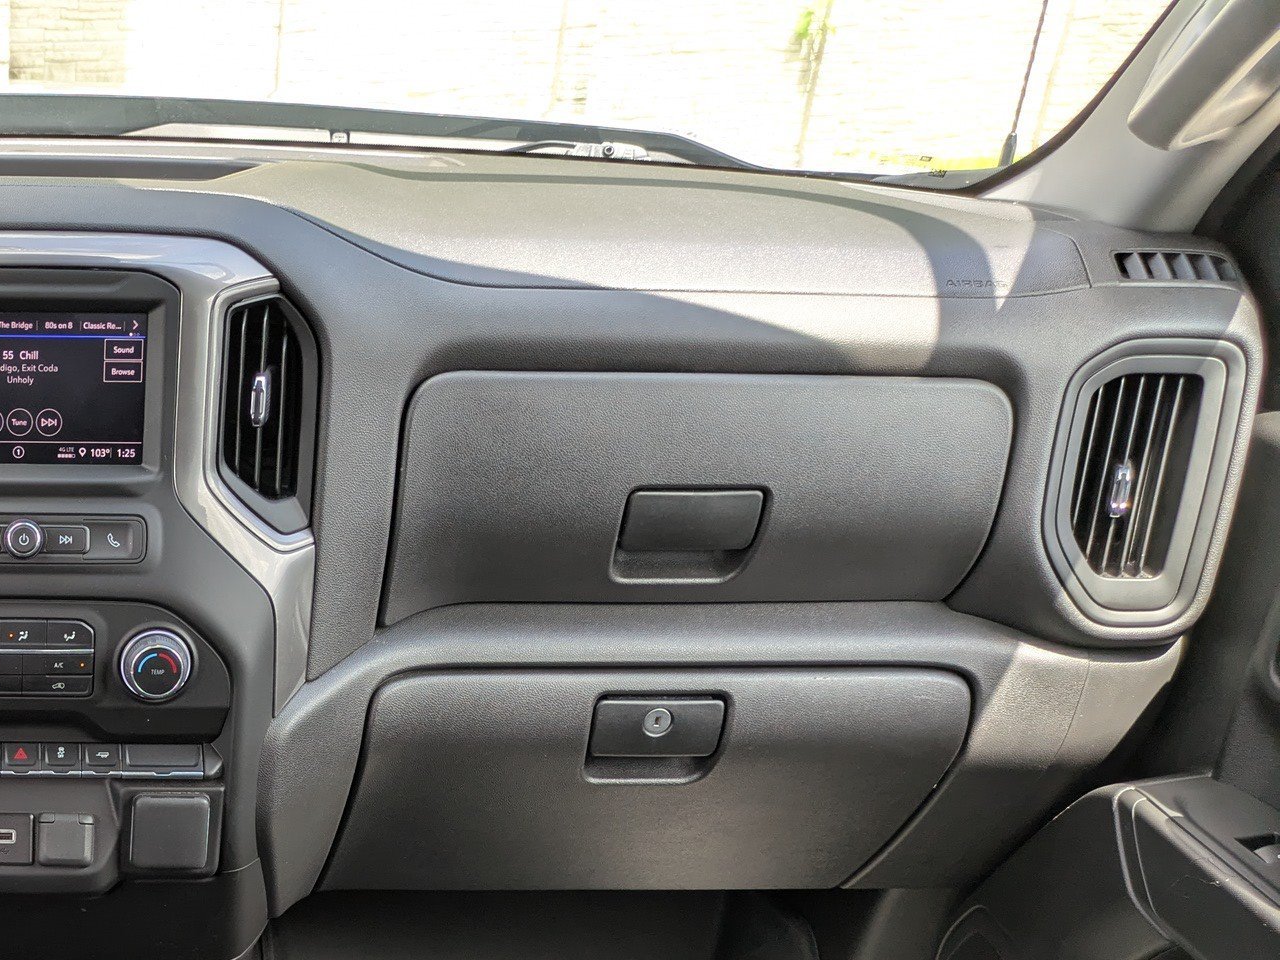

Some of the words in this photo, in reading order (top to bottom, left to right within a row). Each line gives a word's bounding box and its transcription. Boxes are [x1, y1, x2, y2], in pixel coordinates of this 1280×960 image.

[11, 320, 33, 331] Bridge
[45, 321, 57, 329] 80s
[68, 321, 73, 329] 8
[83, 321, 106, 330] Classic
[113, 346, 135, 354] Sound
[2, 350, 14, 360] 55
[19, 350, 39, 360] Chill
[21, 363, 36, 372] Exit
[37, 363, 59, 372] Coda
[111, 368, 135, 376] Browse
[6, 375, 34, 385] Unholy
[12, 418, 28, 426] Tune
[90, 448, 110, 458] 103°
[117, 448, 136, 458] 1:25
